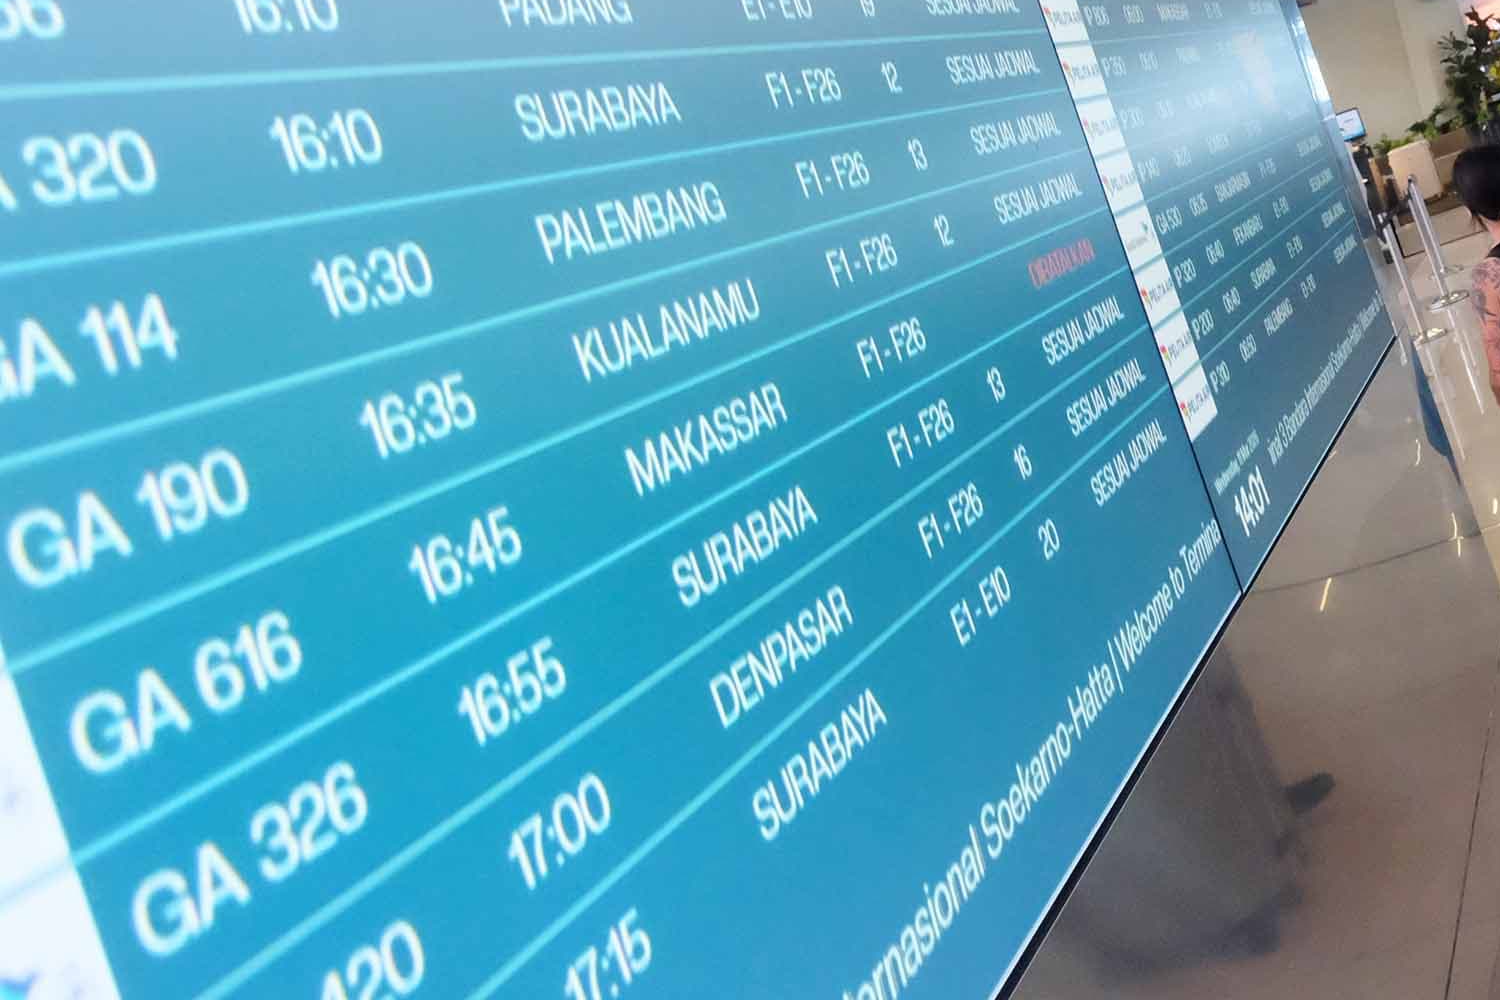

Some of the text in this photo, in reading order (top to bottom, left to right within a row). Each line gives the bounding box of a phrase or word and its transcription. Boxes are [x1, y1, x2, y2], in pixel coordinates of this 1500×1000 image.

[22, 61, 903, 204] 320 16:10 SURABAYA 12
[80, 293, 178, 374] 114
[311, 242, 433, 318] 16:30
[535, 181, 727, 265] PALEMBANG
[907, 138, 929, 171] 13
[7, 172, 1083, 588] GA 190 16:35 KUALANAMU 12 SESUAI JADWAL
[68, 668, 192, 773] GA
[194, 611, 303, 712] 616
[409, 506, 523, 604] 16:45
[624, 382, 788, 497] MAKASSAR
[1027, 237, 1096, 287] DIBATALKAN
[1233, 465, 1271, 537] 14:01
[131, 295, 1125, 956] GA 326 16:55 SURABAYA 13 SESUAI JADWAL
[508, 773, 611, 890] 17:00
[709, 585, 853, 729] DENPASAR
[1013, 444, 1033, 481] 16
[752, 687, 887, 841] SURABAYA
[1037, 518, 1060, 561] 20
[1090, 449, 1131, 507] SESUAI
[1127, 418, 1168, 473] JADWAL
[980, 663, 1116, 859] Soekarno-Hatta
[1113, 583, 1174, 672] Welcome
[1167, 566, 1185, 600] to
